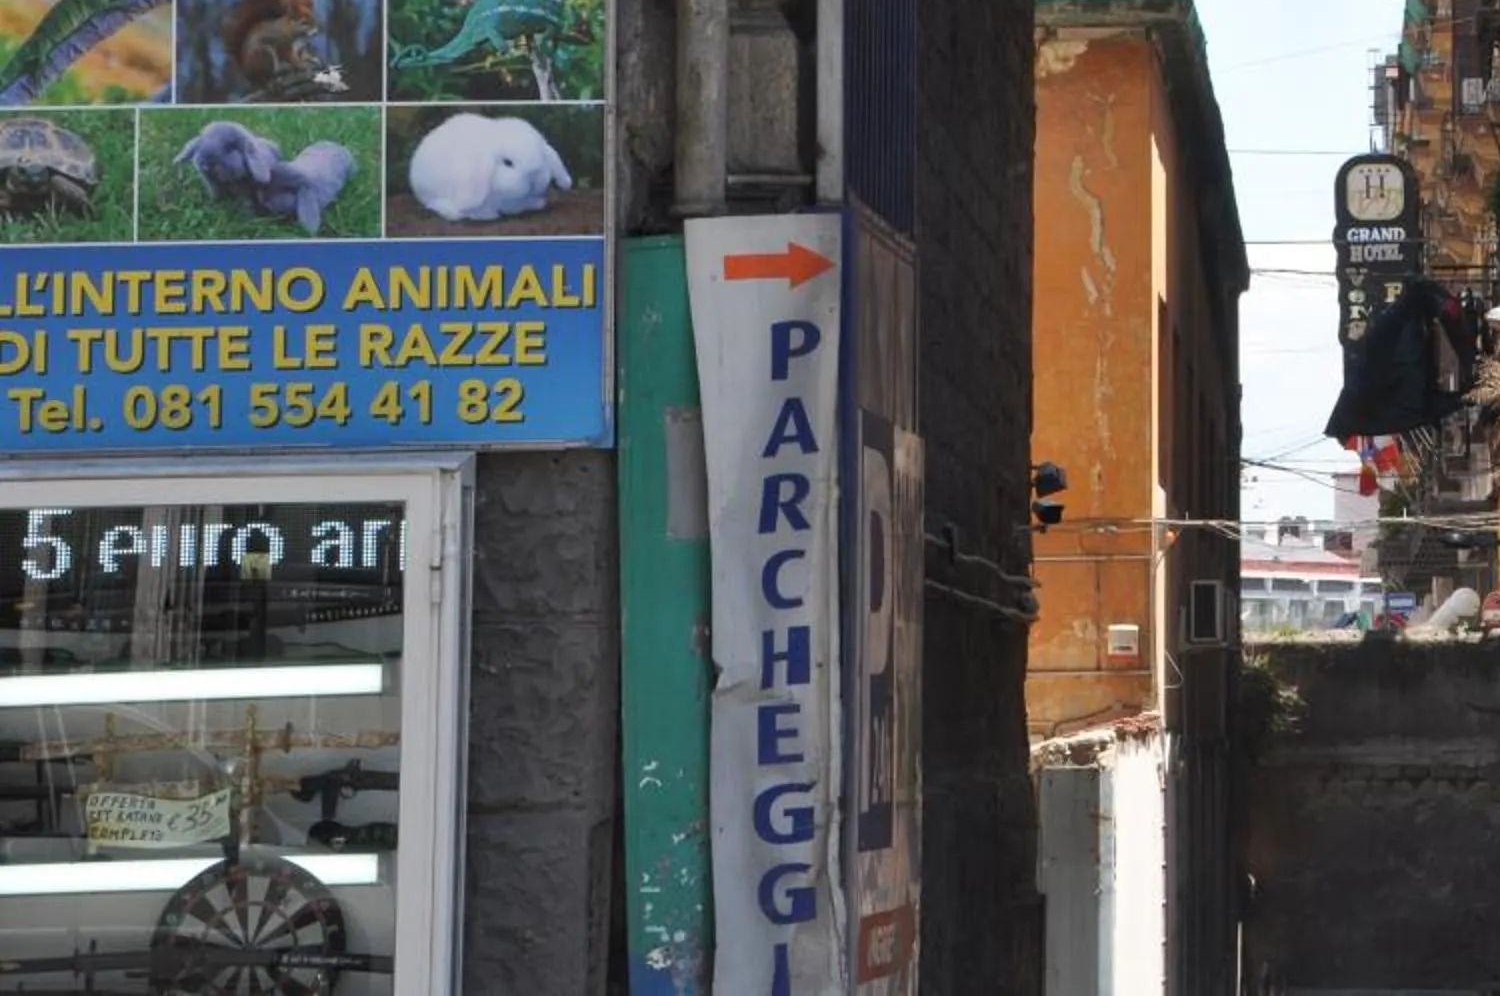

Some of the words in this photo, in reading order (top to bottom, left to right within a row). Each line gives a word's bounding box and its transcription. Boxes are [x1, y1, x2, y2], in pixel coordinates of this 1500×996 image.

[1346, 227, 1406, 243] GRAND
[1350, 243, 1404, 263] HOTEL
[0, 268, 325, 317] L'INTERNO
[342, 264, 596, 311] ANIMALI
[0, 329, 48, 375] DI
[67, 325, 252, 373] TUTTE
[273, 324, 337, 370] LE
[359, 320, 547, 367] RAZZE
[8, 385, 104, 432] Tel.
[122, 383, 223, 430] 081
[247, 381, 352, 427] 554
[368, 380, 433, 425] 41
[457, 377, 526, 423] 82
[21, 508, 72, 580] 5
